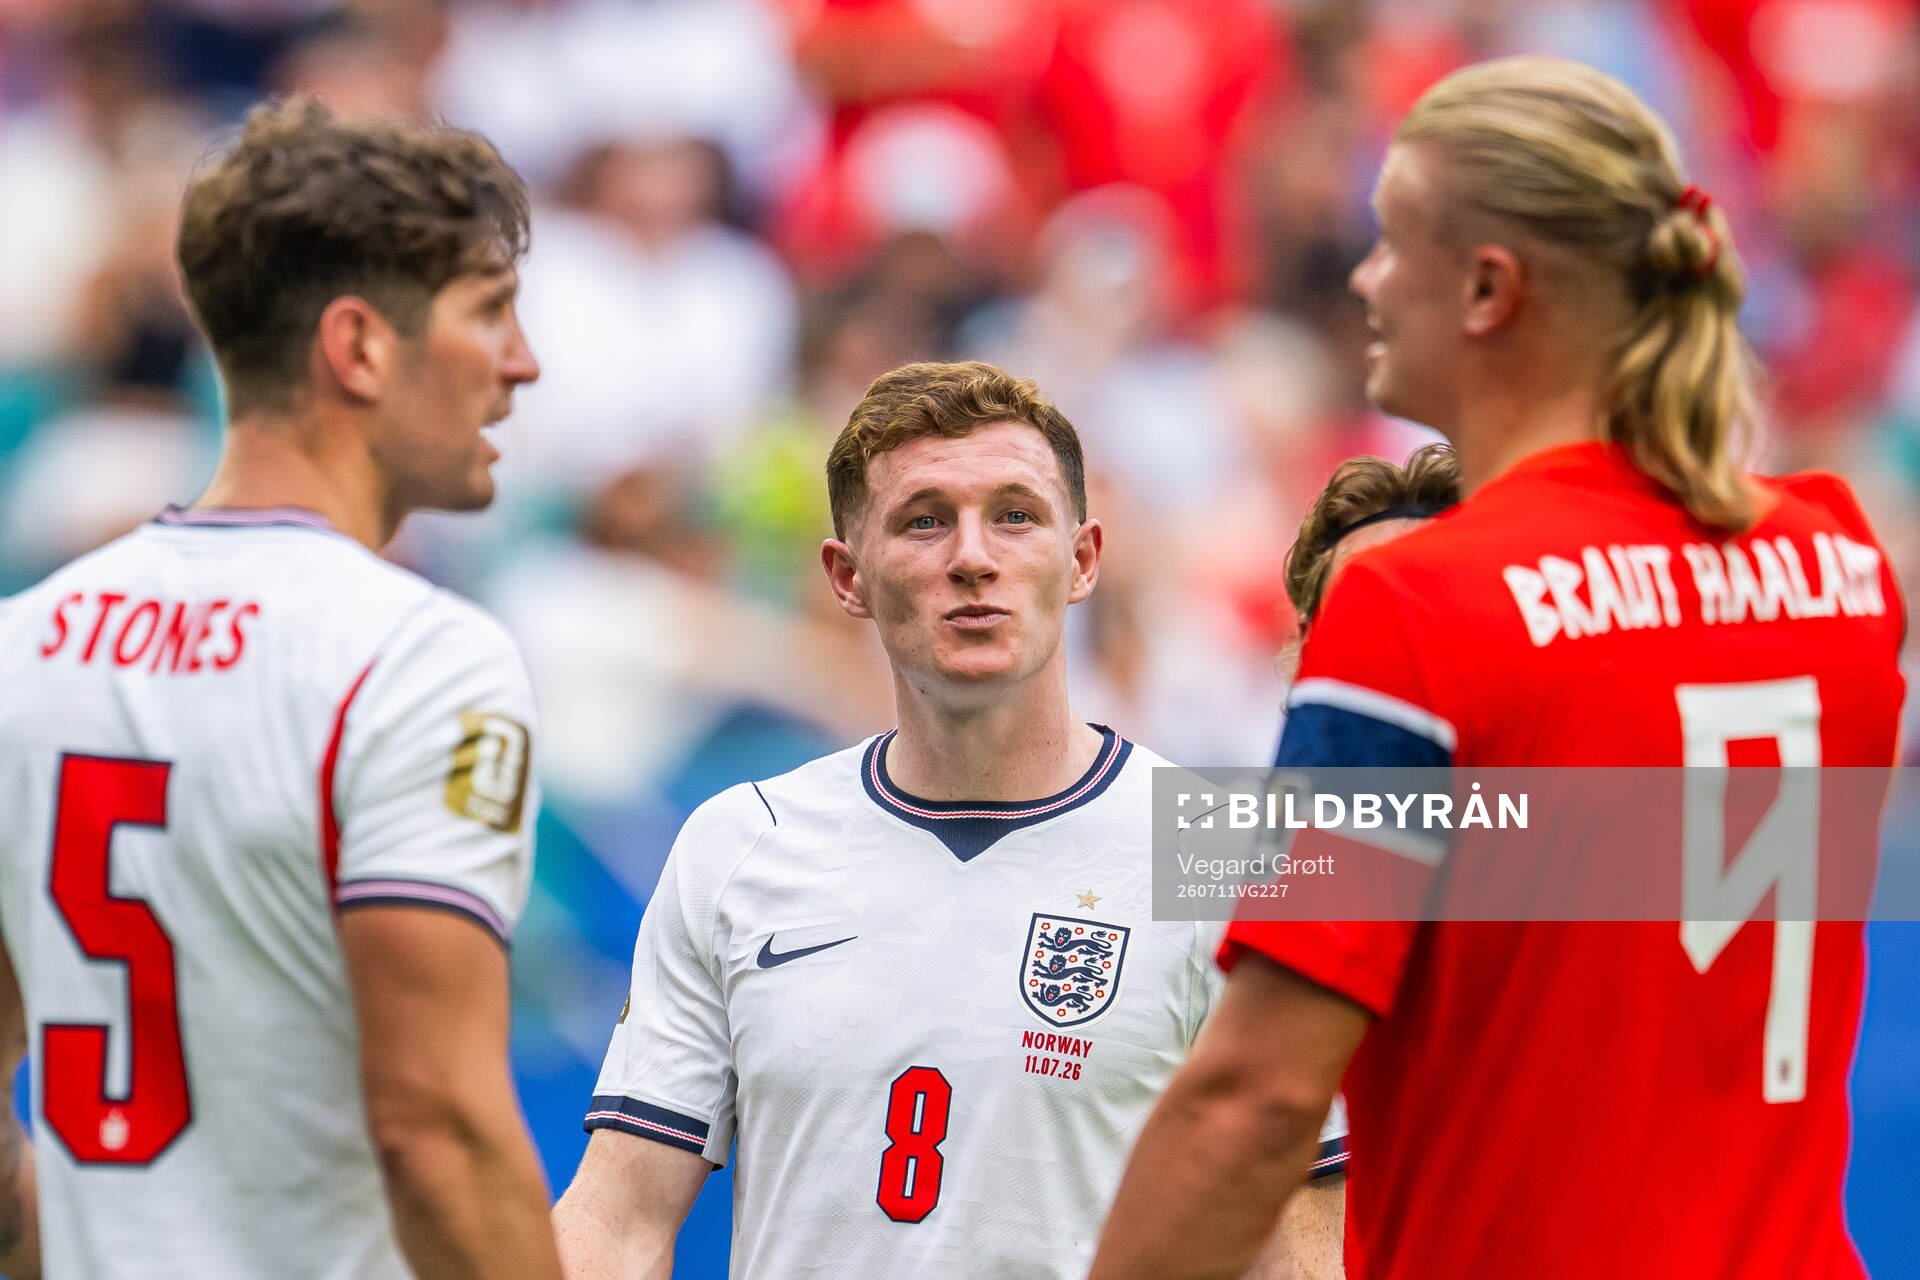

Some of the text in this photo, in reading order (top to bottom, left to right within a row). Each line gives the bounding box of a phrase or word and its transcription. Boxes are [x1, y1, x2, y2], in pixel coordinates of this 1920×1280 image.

[40, 592, 261, 675] STONES
[1503, 545, 1681, 648] BRAUT
[1675, 675, 1821, 1103] 9
[41, 752, 193, 1167] 5
[1021, 1030, 1093, 1058] NORWAY
[1024, 1055, 1082, 1081] 11.07.26
[876, 1065, 952, 1224] 8
